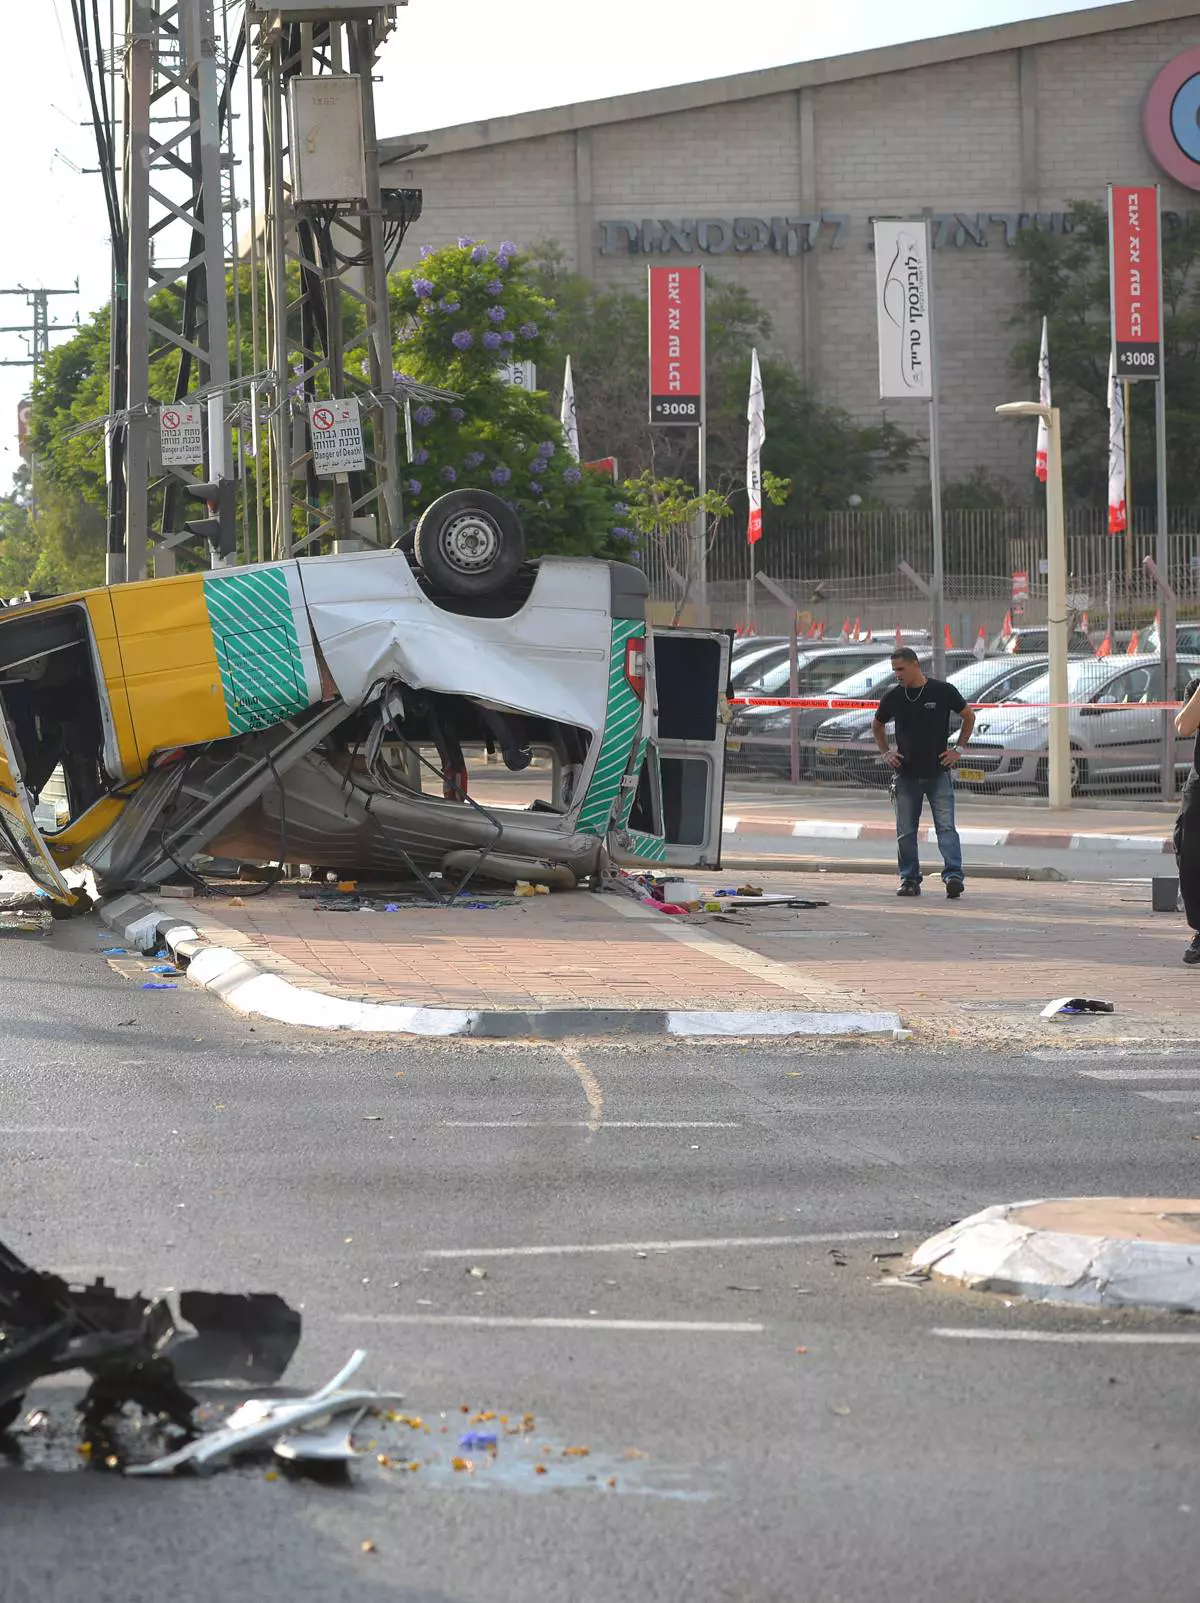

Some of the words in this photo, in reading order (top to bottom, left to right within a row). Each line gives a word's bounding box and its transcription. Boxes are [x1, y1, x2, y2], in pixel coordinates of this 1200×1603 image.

[599, 210, 850, 256] לקופסאות
[1130, 236, 1140, 263] צא
[668, 272, 681, 304] בוא,
[904, 255, 923, 323] לובינסקי
[1130, 268, 1141, 296] עם
[668, 308, 680, 330] צא
[1131, 302, 1142, 336] רכב
[669, 335, 680, 358] עם
[910, 329, 922, 370] טרייד
[669, 362, 680, 391] רכב
[313, 430, 336, 440] גבוה!
[313, 440, 336, 450] מוות!
[338, 437, 360, 447] סכנת
[340, 427, 360, 437] מתח
[314, 451, 335, 460] Danger
[342, 446, 362, 457] Death!
